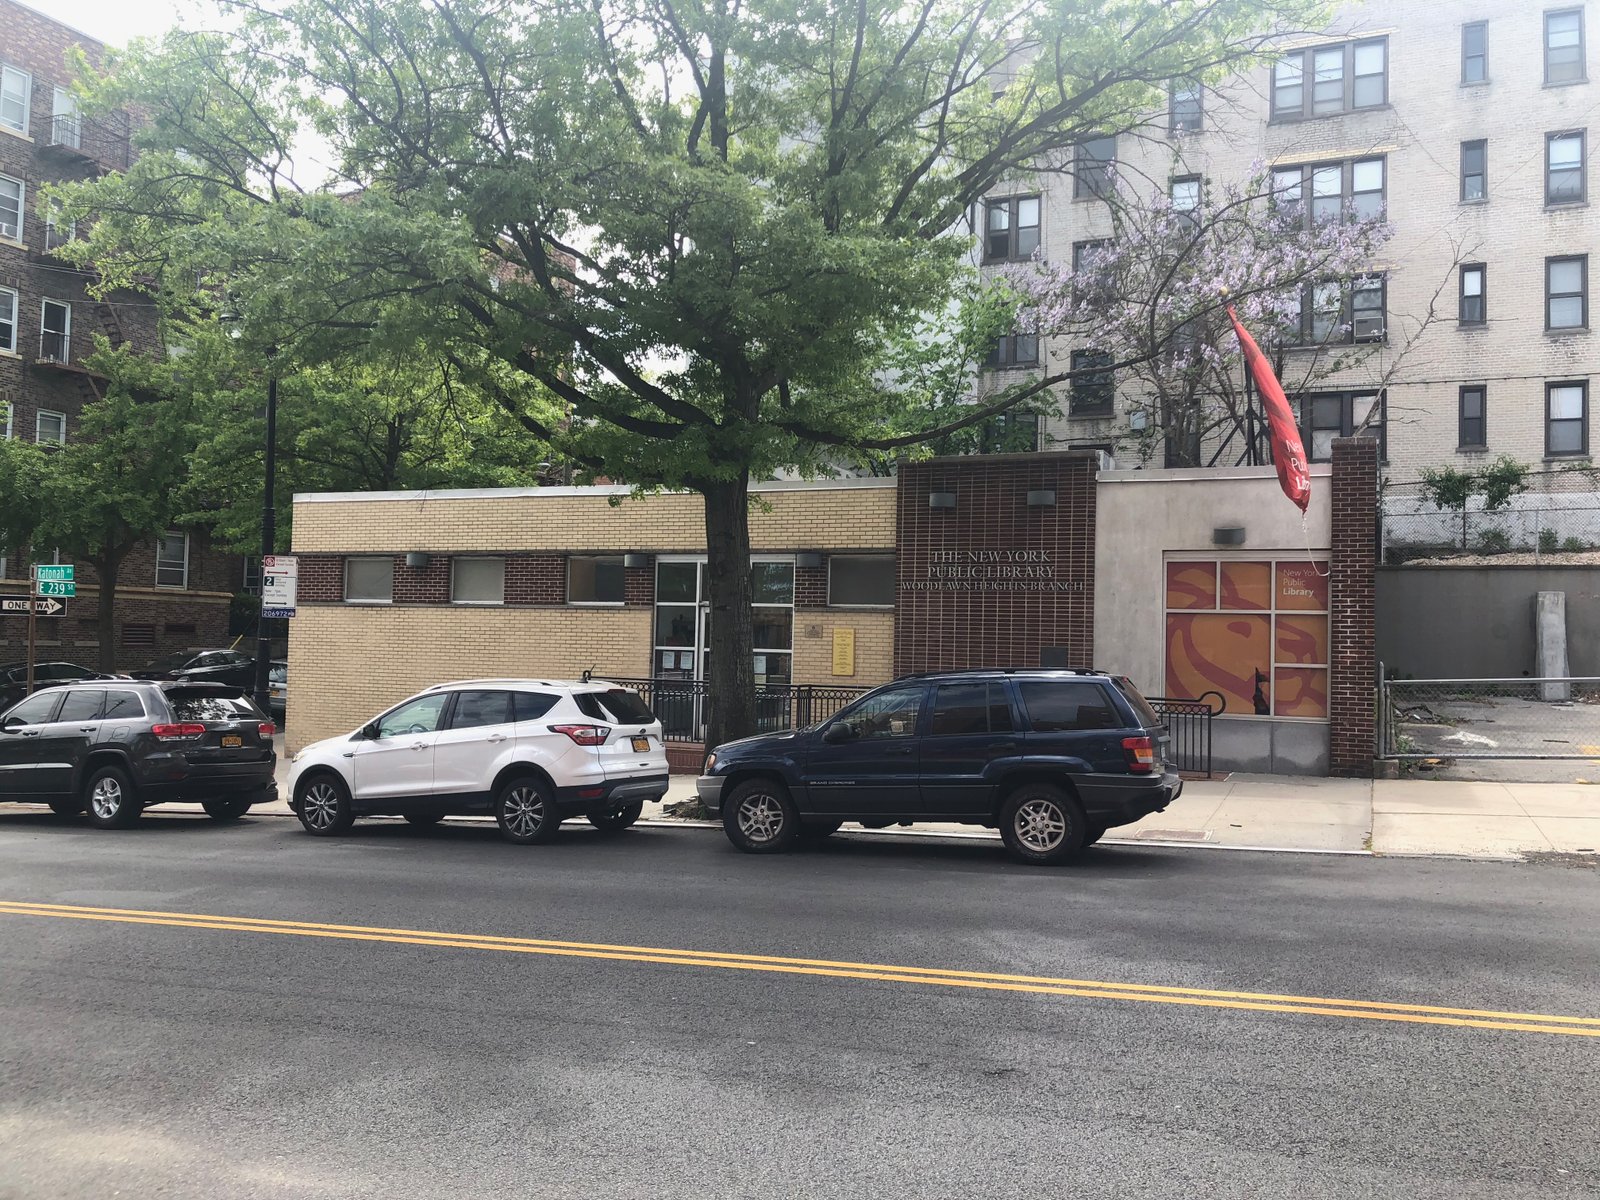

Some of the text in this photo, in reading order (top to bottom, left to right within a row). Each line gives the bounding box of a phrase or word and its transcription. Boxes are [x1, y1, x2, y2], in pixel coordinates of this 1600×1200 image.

[931, 550, 1051, 562] THE NEW YORK
[38, 566, 65, 579] Katonah
[928, 566, 1055, 578] PUBLIC LIBRARY
[266, 576, 273, 586] 2
[902, 581, 1083, 591] WOODLAWN HEIGHTS BRANCH
[1283, 578, 1306, 586] Public
[39, 582, 45, 593] E
[48, 583, 65, 594] 239
[1283, 588, 1314, 597] Library
[7, 601, 56, 610] ONE WAY
